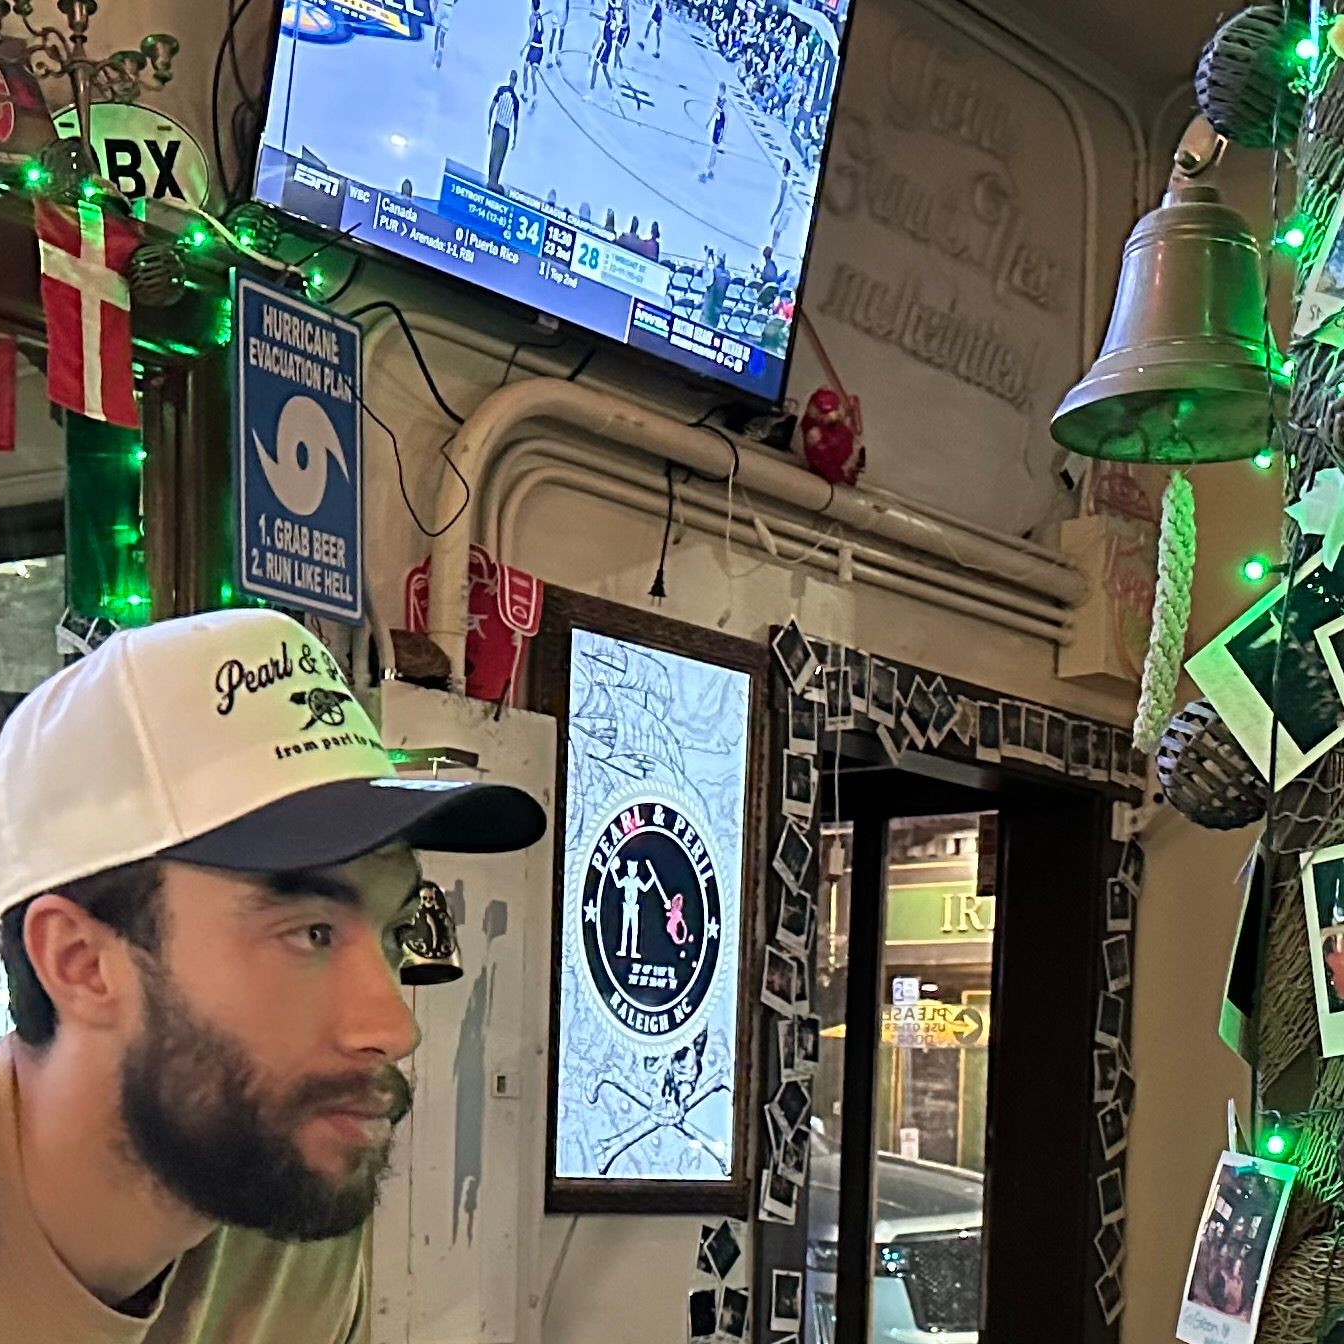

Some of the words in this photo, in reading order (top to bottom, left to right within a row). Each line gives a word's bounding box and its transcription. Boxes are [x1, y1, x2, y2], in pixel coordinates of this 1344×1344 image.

[93, 138, 186, 200] BX
[293, 163, 340, 197] ESPN
[349, 185, 371, 204] WBC
[381, 197, 419, 223] Canada
[379, 215, 399, 233] PUR
[515, 215, 539, 247] 34
[469, 231, 498, 256] Puerto
[498, 243, 520, 265] Rico
[577, 243, 599, 270] 28
[263, 304, 340, 364] HURRICANE
[249, 337, 321, 392] EVACUATION
[323, 366, 353, 403] PLAN
[259, 513, 272, 545] 1.
[274, 526, 310, 560] GRAB
[313, 532, 347, 569] BEER
[251, 548, 264, 576] 2.
[266, 553, 291, 587] RUN
[294, 559, 323, 595] LIKE
[324, 566, 353, 601] HELL
[215, 641, 293, 715] Pearl
[298, 643, 321, 676] &
[274, 737, 319, 760] from
[592, 804, 646, 874] PEARL
[652, 804, 666, 826] &
[672, 813, 714, 888] PERIL
[609, 991, 670, 1033] RALEIGH
[673, 997, 693, 1024] NC
